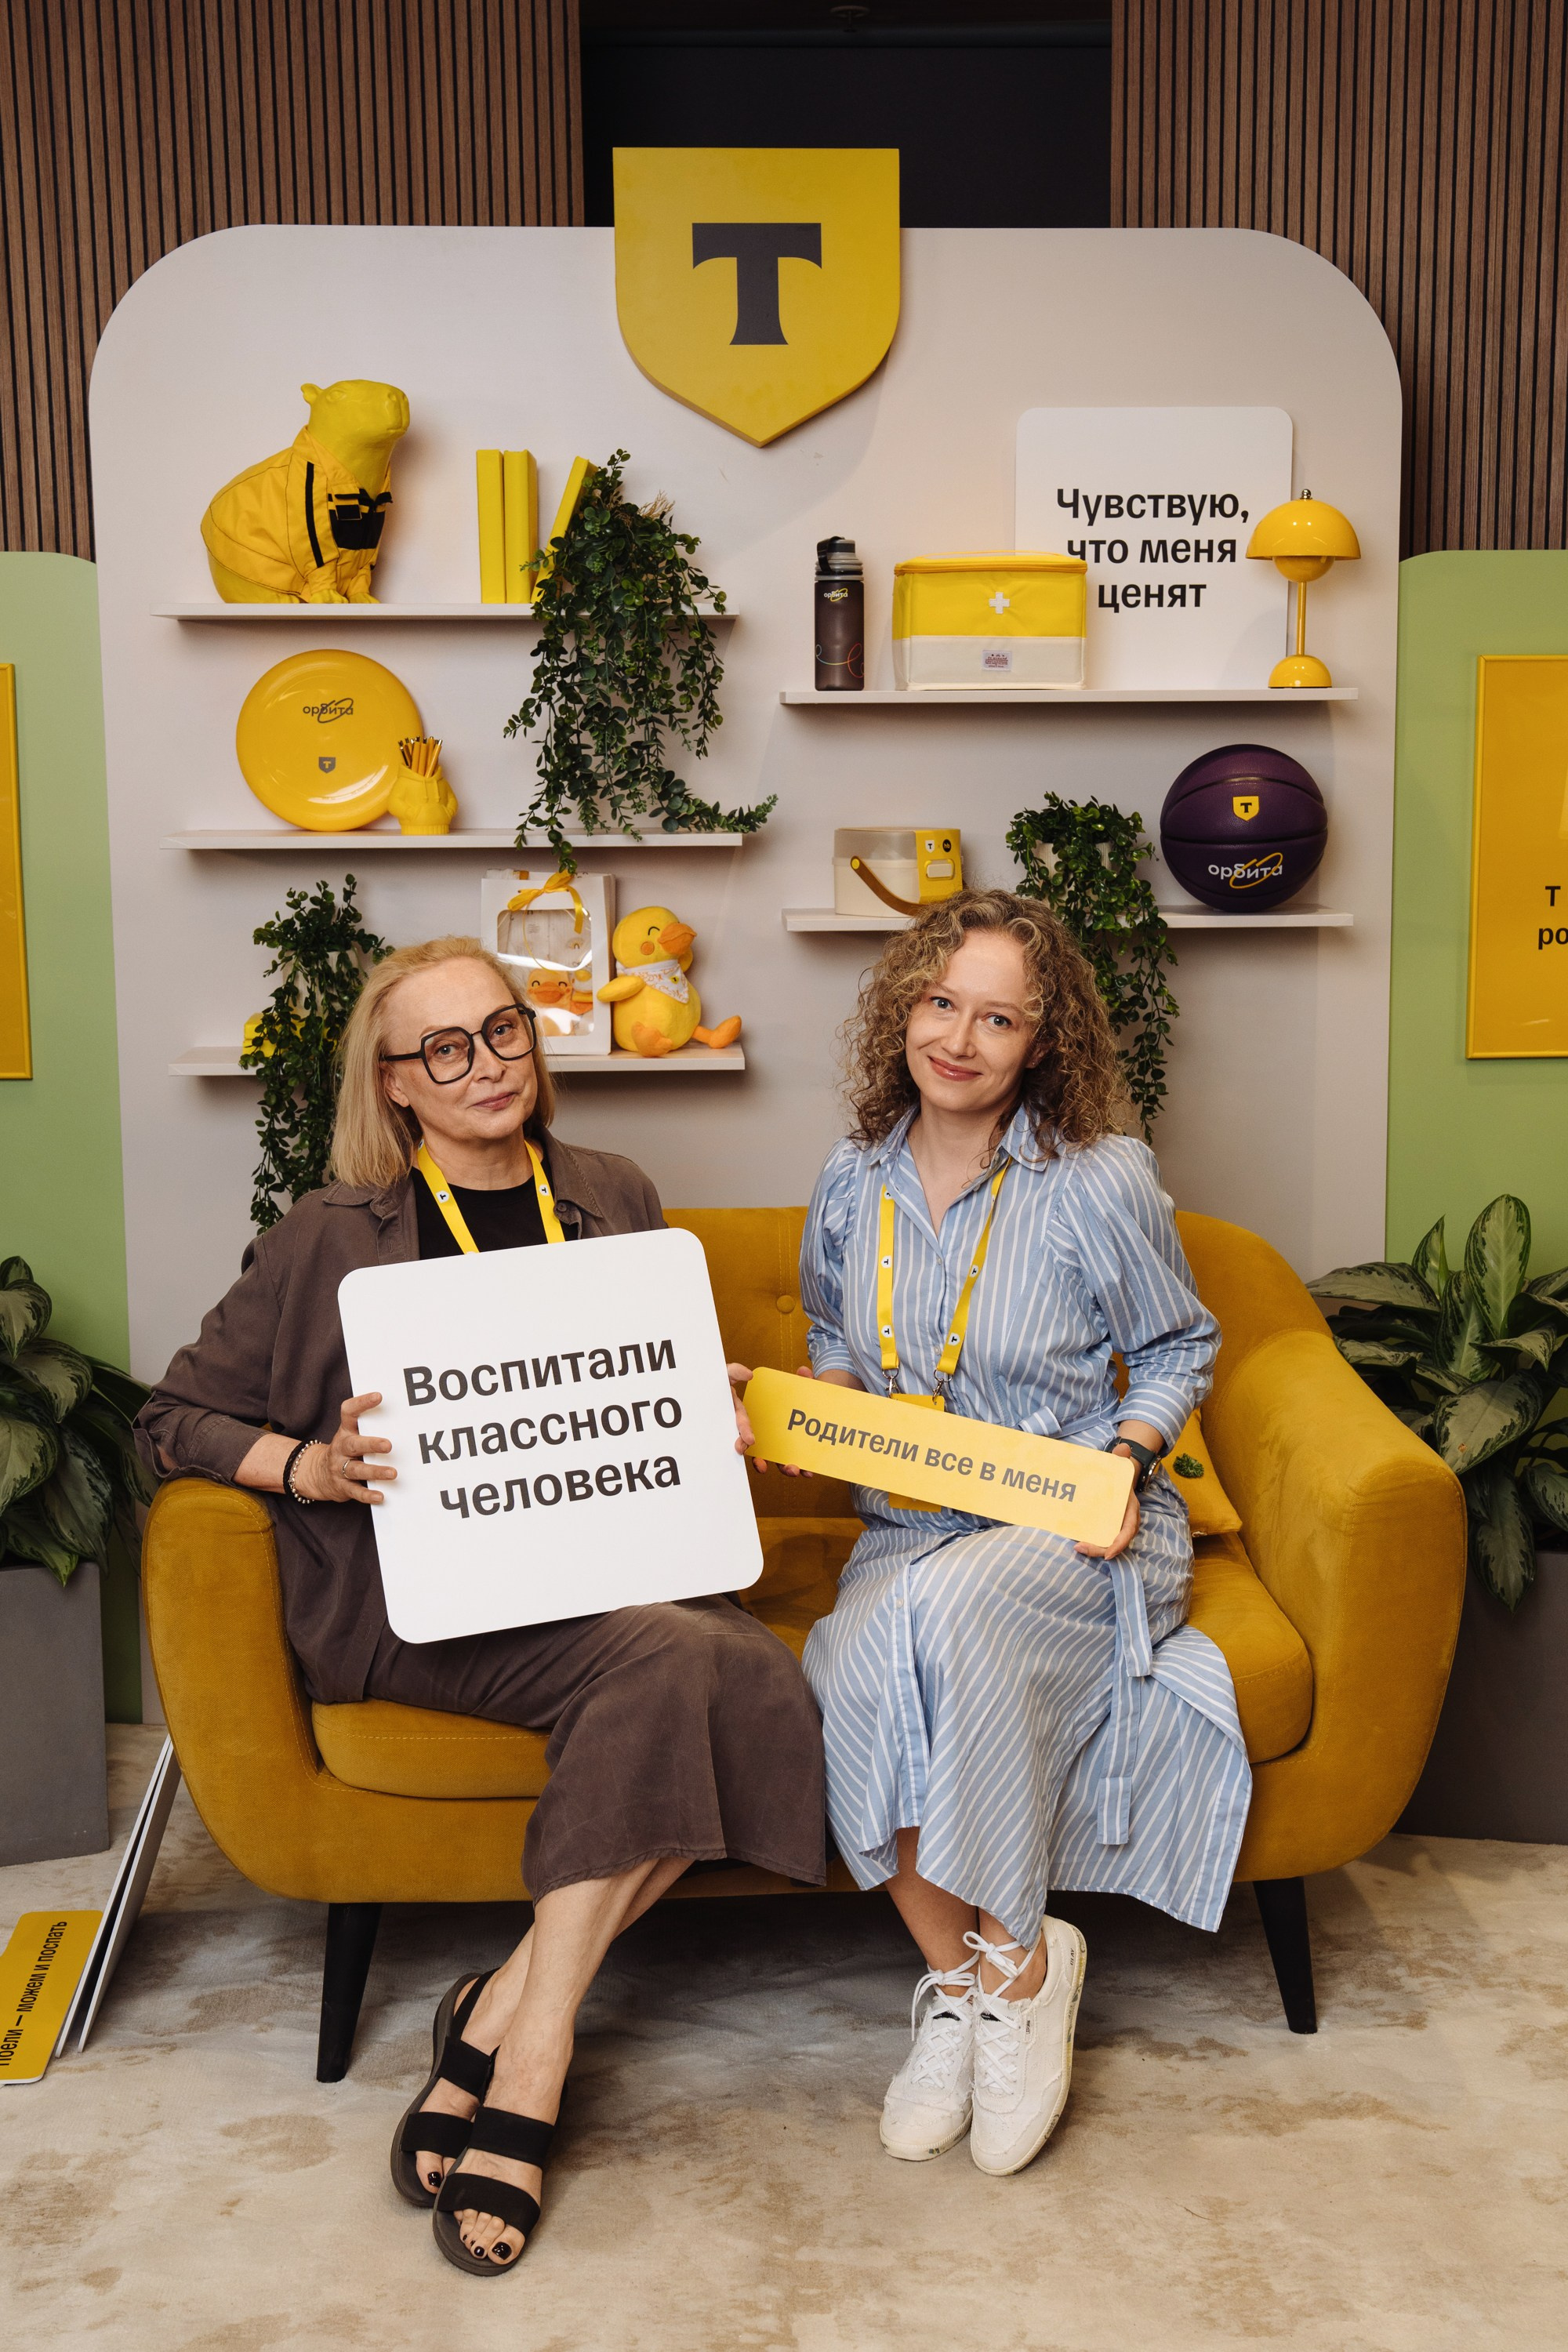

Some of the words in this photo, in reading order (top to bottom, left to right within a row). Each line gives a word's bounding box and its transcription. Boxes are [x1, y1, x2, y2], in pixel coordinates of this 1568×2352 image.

[1058, 488, 1249, 526] Чувствую,
[1068, 539, 1128, 564] что
[1139, 539, 1236, 563] меня
[823, 590, 848, 599] орбита
[1098, 584, 1207, 613] ценят
[303, 702, 354, 717] орбита
[1208, 860, 1283, 881] орбита
[404, 1339, 677, 1406] Воспитали
[419, 1397, 682, 1465] классного
[787, 1409, 919, 1462] Родители
[924, 1448, 973, 1475] все
[979, 1461, 995, 1481] в
[1002, 1468, 1076, 1502] меня
[440, 1456, 681, 1519] человека
[16, 1973, 47, 2012] можем
[38, 1921, 67, 1962] поспать
